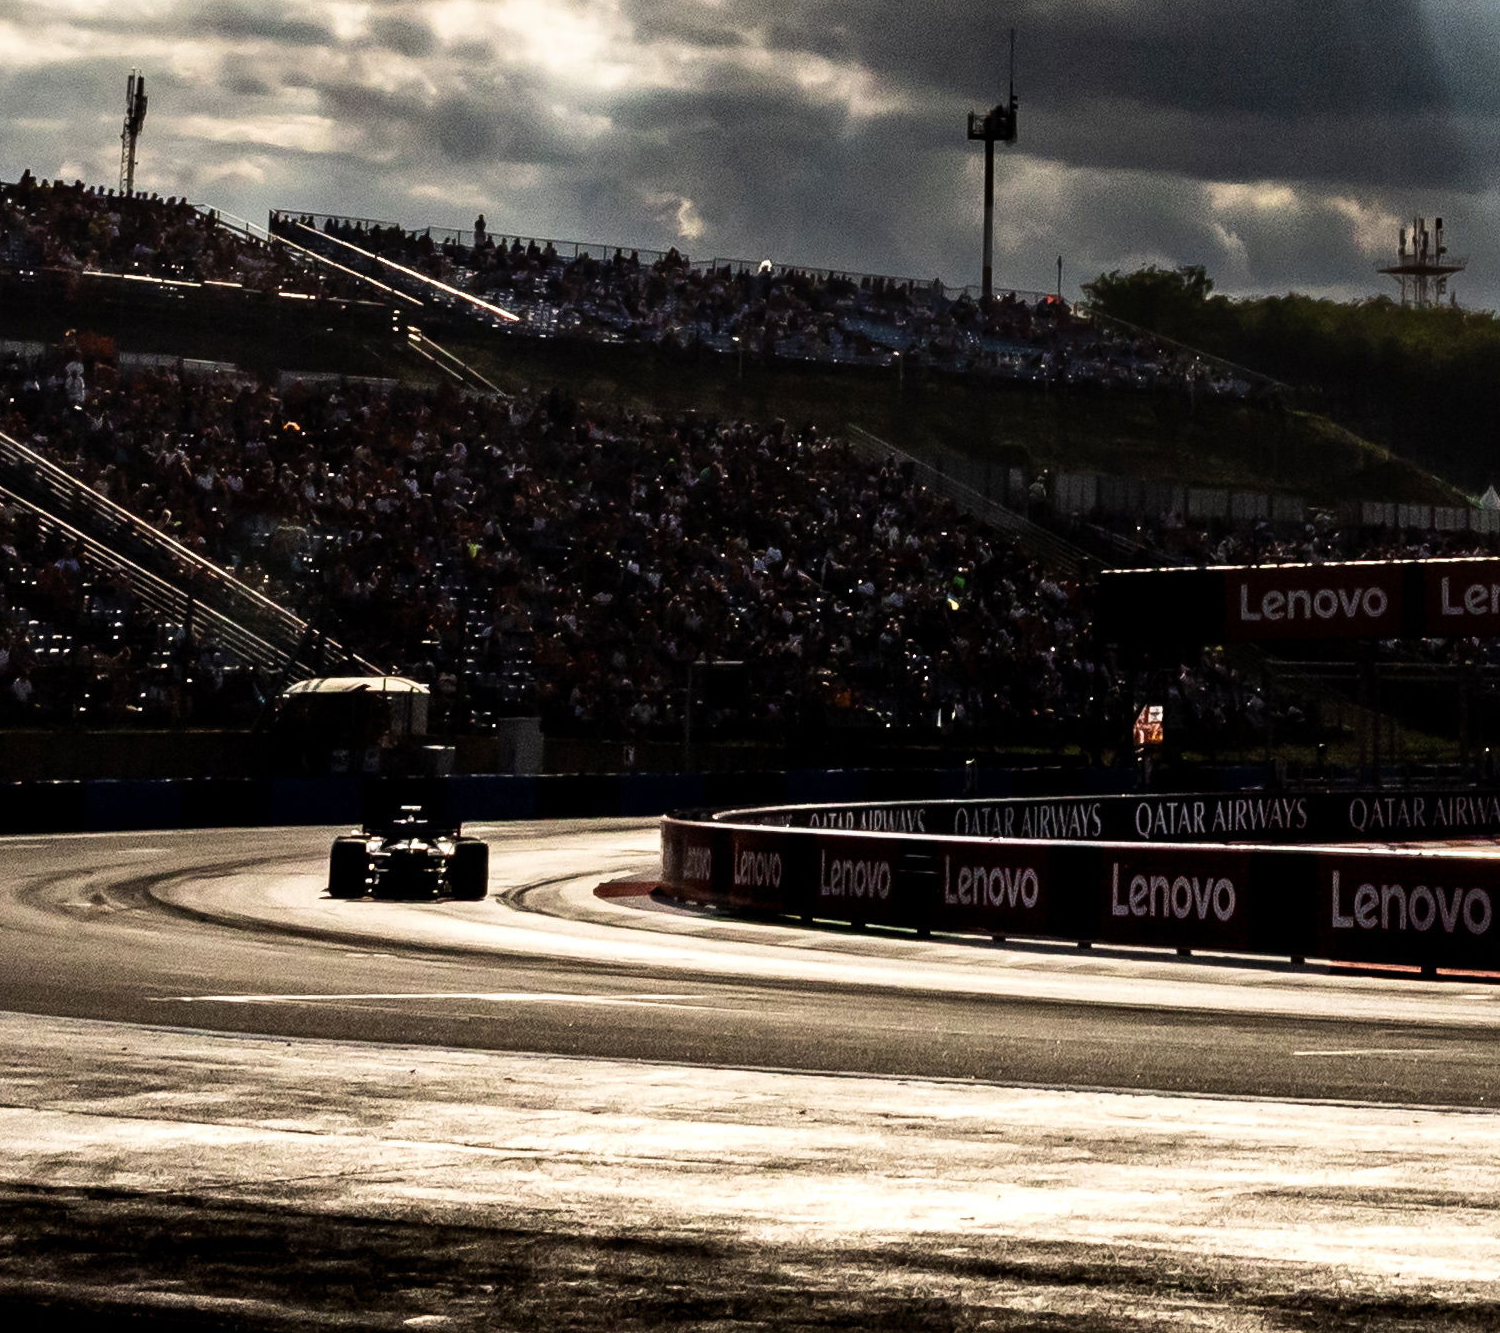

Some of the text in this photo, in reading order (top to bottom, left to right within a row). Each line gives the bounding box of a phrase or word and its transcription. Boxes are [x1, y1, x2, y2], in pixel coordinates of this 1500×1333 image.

[1239, 583, 1388, 621] Lenovo
[953, 803, 1102, 838] QATAR AIRWAYS
[1135, 797, 1308, 839] QATAR AIRWAYS
[1348, 797, 1426, 831] QATAR
[734, 850, 782, 888] Lenovo
[820, 849, 892, 900] Lenovo
[944, 856, 1039, 908] Lenovo
[1111, 863, 1236, 921] Lenovo
[1331, 870, 1492, 935] Lenovo
